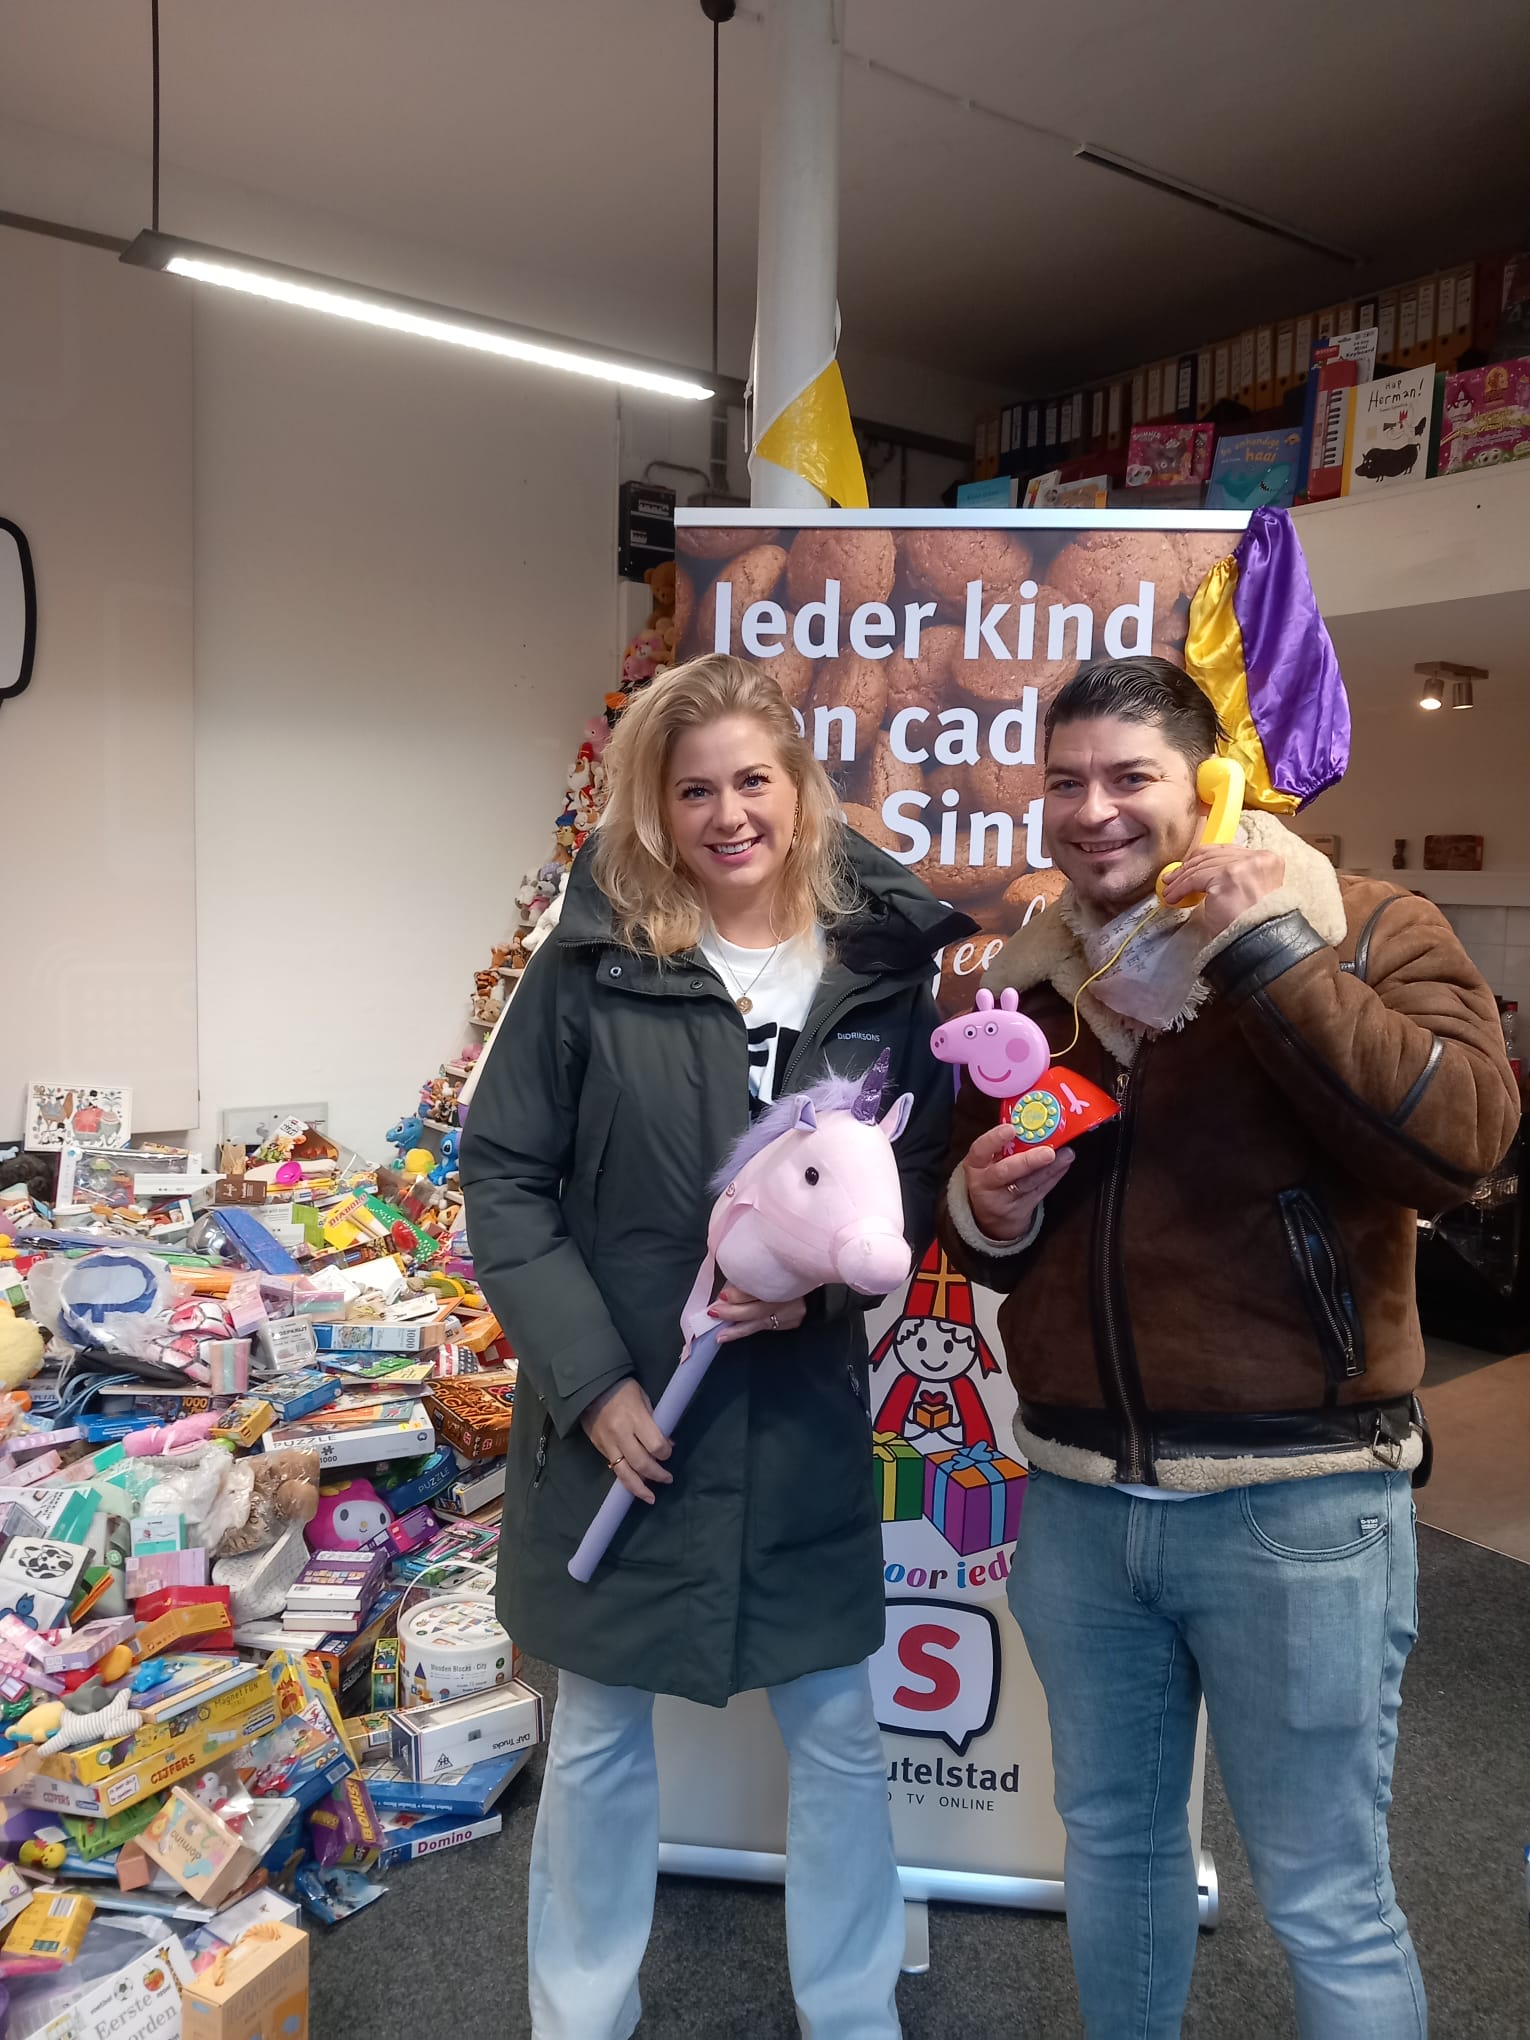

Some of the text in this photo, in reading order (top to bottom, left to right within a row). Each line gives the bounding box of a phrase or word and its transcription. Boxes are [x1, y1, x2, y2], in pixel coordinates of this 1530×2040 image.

[714, 579, 1155, 660] Ieder kind
[837, 1032, 881, 1042] DIDRIKSONS
[406, 1328, 416, 1349] 1000
[181, 1396, 208, 1408] 1000
[273, 1434, 336, 1448] PUZZLE
[319, 1455, 338, 1464] 1000
[418, 1467, 450, 1493] PUZZLE
[879, 1551, 1015, 1589] oor ied
[430, 1663, 451, 1672] Wooden
[452, 1663, 472, 1672] Blocks
[893, 1623, 961, 1712] S
[214, 1688, 243, 1708] Magnet
[492, 1733, 531, 1750] DAF Trucks
[151, 1753, 196, 1784] CIJFERS
[907, 1793, 925, 1805] TV
[939, 1796, 995, 1811] ONLINE
[170, 1830, 202, 1862] domino
[417, 1829, 473, 1853] Domino
[94, 1993, 152, 2040] Eerste
